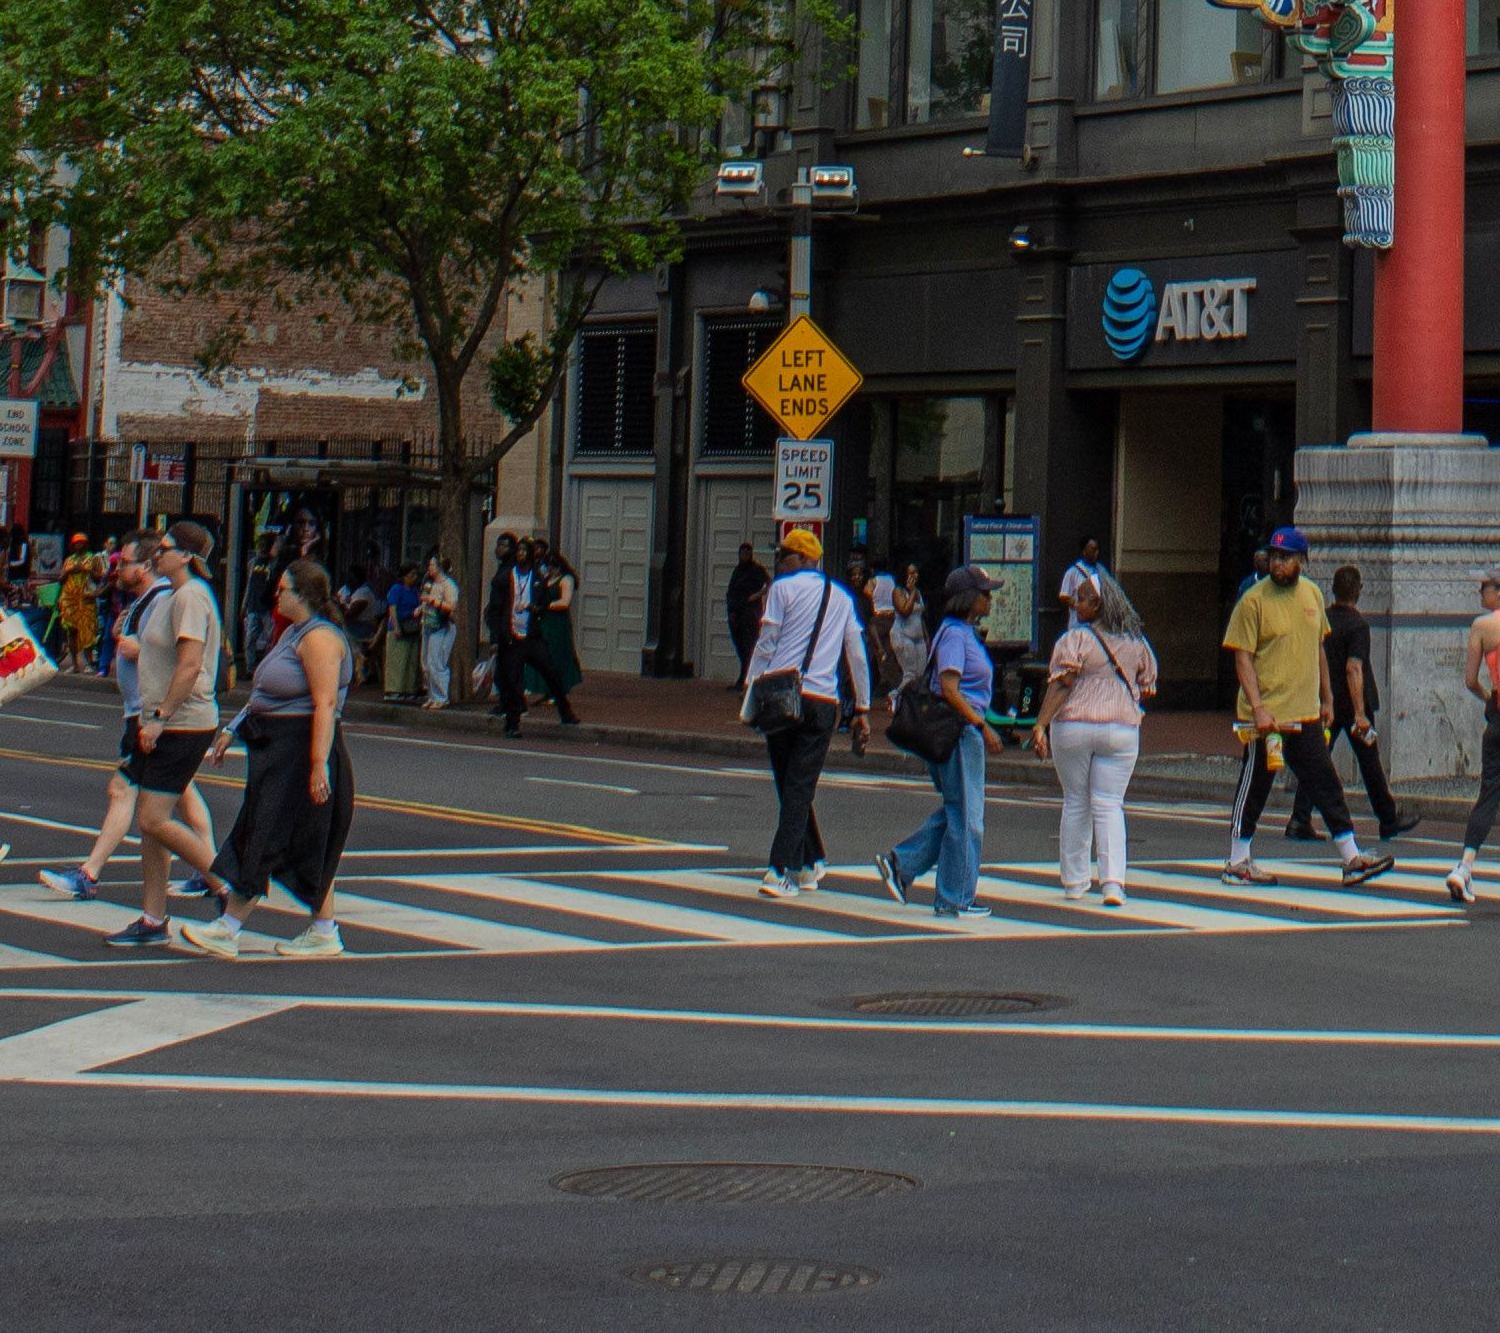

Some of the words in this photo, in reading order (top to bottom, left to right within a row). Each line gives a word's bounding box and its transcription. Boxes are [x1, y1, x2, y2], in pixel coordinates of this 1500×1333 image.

[1155, 277, 1257, 343] AT&T
[782, 349, 825, 368] LEFT
[778, 374, 827, 392] LANE
[780, 398, 829, 416] ENDS
[2, 437, 26, 447] ZONE
[781, 449, 828, 463] SPEED
[785, 465, 822, 479] LIMIT
[783, 482, 822, 510] 25
